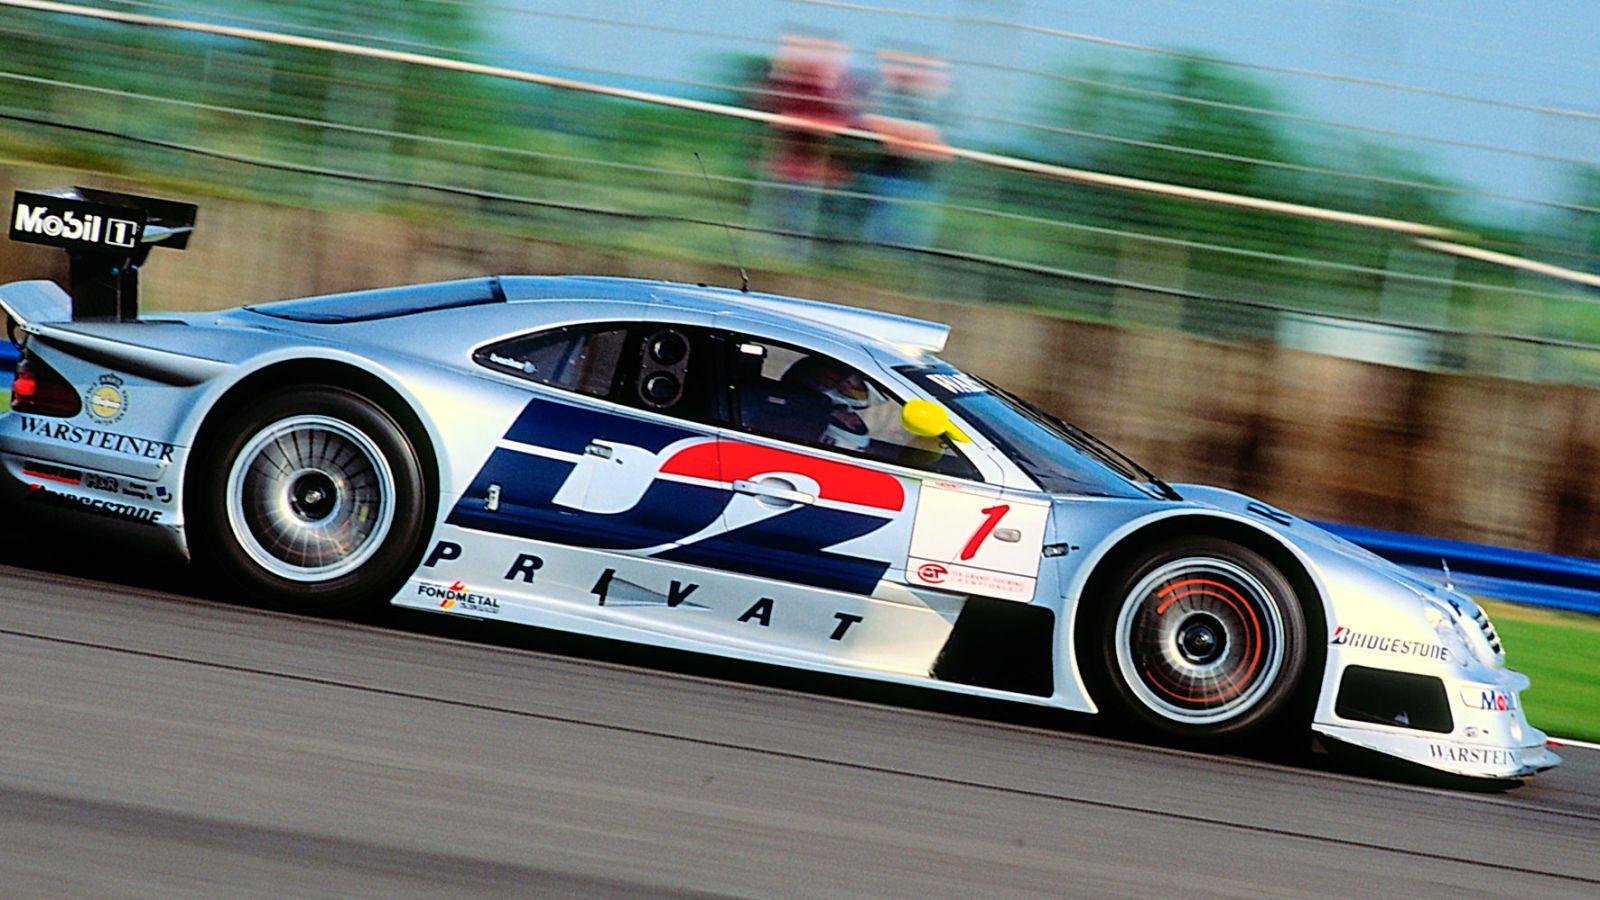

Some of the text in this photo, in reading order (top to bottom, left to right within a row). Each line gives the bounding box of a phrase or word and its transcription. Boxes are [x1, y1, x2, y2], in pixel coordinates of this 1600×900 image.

[14, 203, 102, 243] Mobil
[20, 416, 175, 463] WARSTEINER
[28, 483, 163, 527] DGESTONE
[444, 397, 905, 597] D2
[960, 504, 1010, 561] 1
[417, 585, 500, 608] FONDMETAL
[423, 540, 863, 642] PRIVAT
[1331, 626, 1449, 661] BRIDGESTONE
